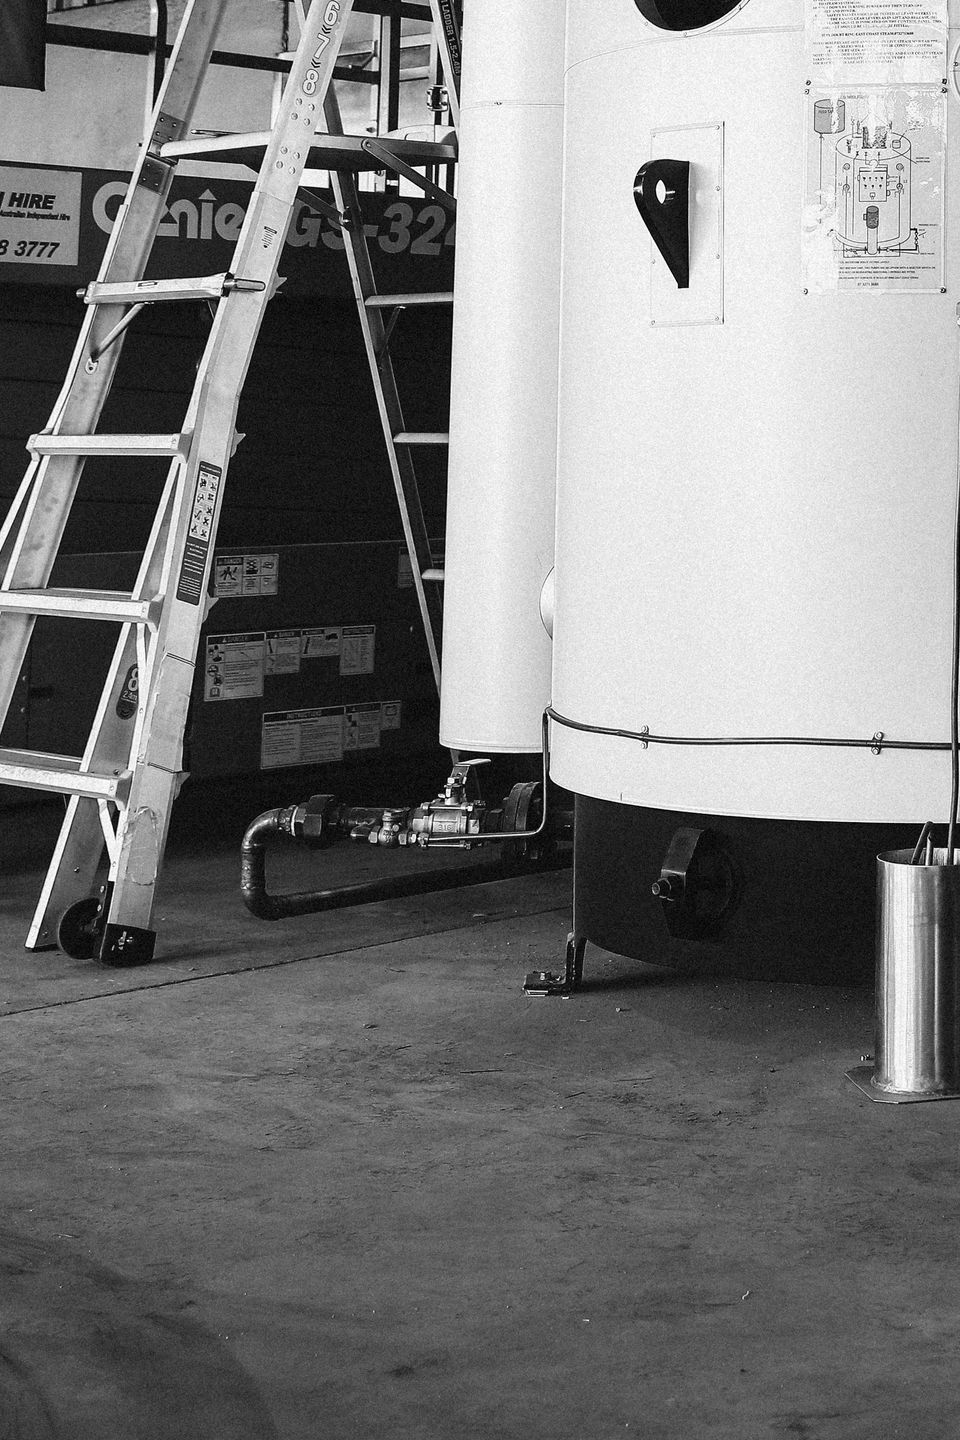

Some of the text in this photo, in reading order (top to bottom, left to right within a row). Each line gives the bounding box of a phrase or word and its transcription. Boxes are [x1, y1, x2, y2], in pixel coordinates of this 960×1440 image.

[323, 0, 340, 27] 6
[442, 5, 455, 36] LADDER
[314, 33, 331, 60] 7
[302, 68, 319, 96] 8
[8, 191, 57, 210] HIRE
[14, 240, 61, 258] 3777
